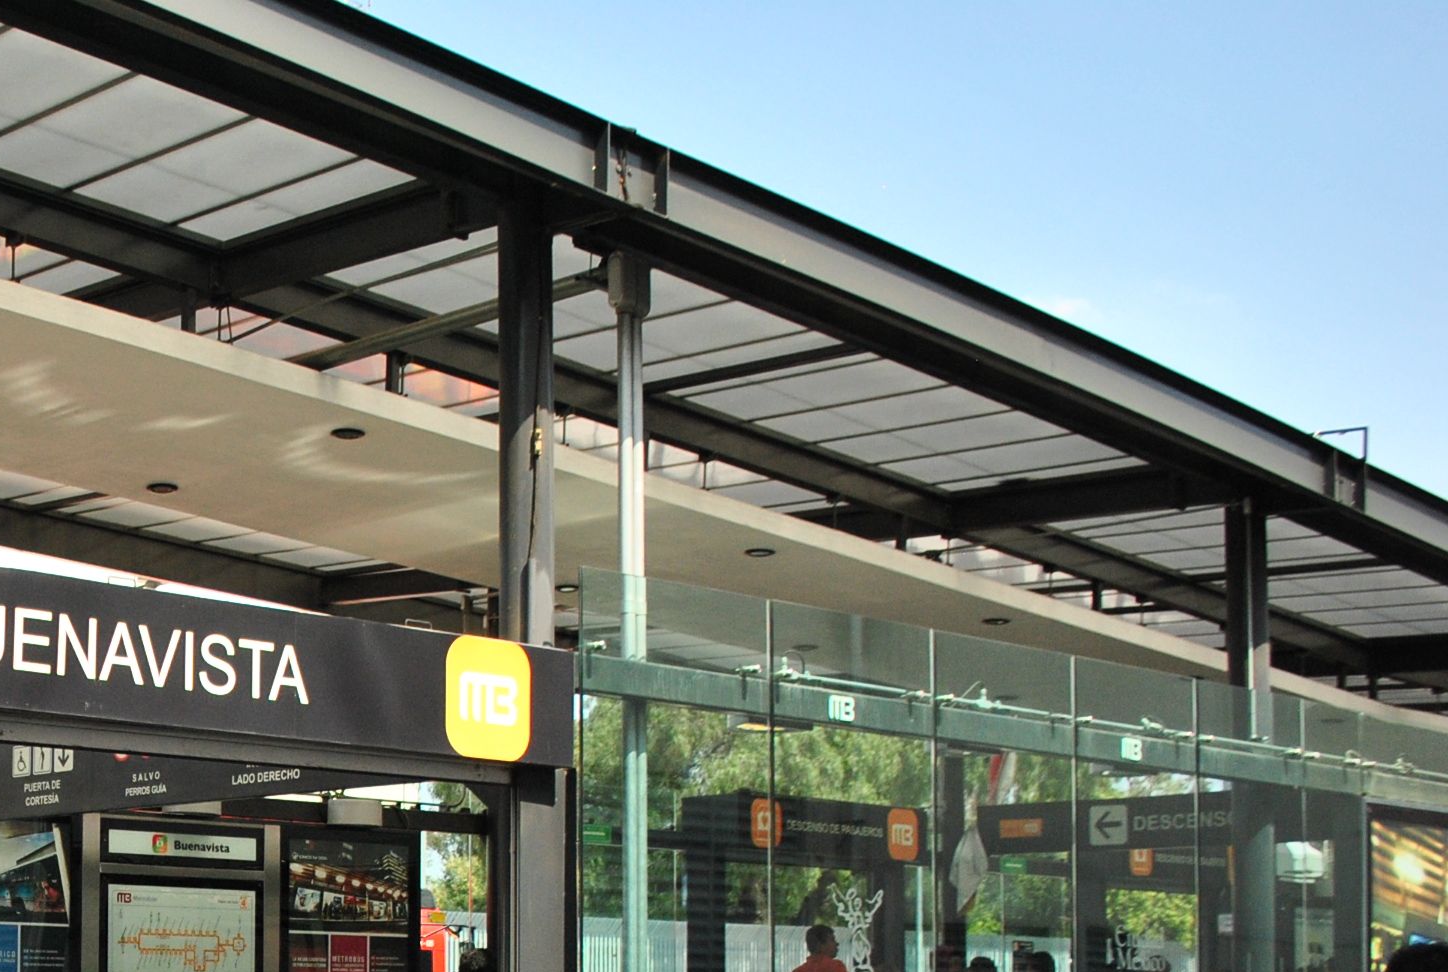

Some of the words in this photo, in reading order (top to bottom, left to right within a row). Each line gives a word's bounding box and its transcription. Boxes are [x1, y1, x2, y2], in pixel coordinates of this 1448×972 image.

[132, 771, 160, 783] SALVO
[232, 774, 256, 785] LADO
[257, 768, 300, 783] DERECHO
[24, 783, 50, 793] PUERTA
[51, 780, 61, 790] DE
[125, 787, 150, 797] PERROS
[152, 784, 167, 794] GUÍA
[25, 793, 59, 807] CORTESÍA
[1132, 811, 1232, 831] DESCENS
[786, 819, 828, 833] DESCENSO
[830, 824, 840, 834] DE
[841, 824, 883, 838] PASAJEROS
[174, 840, 230, 853] Buenavista
